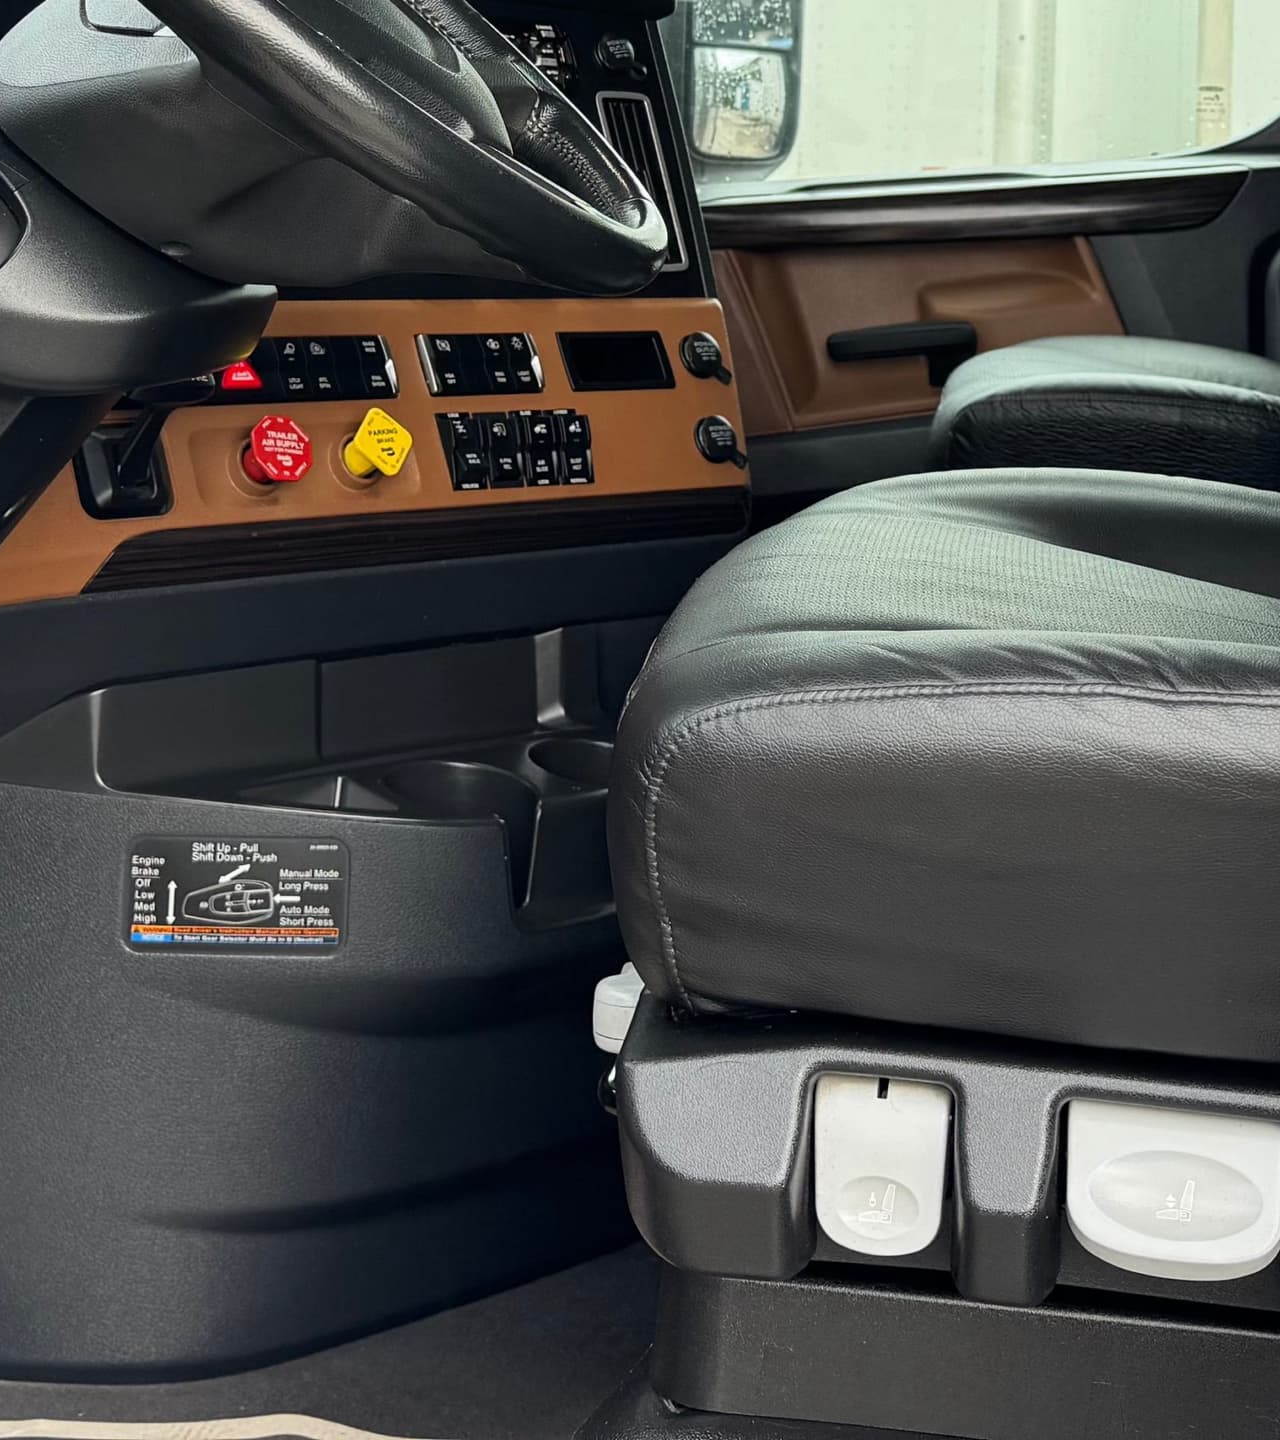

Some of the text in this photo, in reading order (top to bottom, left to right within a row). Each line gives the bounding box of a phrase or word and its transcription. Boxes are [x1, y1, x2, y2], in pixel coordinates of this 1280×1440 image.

[266, 430, 298, 441] TRAILER
[368, 427, 398, 437] PARKING
[262, 438, 305, 449] AIR SUPPLY
[192, 842, 215, 853] Shift
[217, 842, 231, 853] Up
[240, 842, 259, 853] Pull
[132, 855, 166, 866] Engine
[192, 852, 214, 862] Shift
[216, 852, 244, 862] Down
[252, 852, 278, 862] Push
[131, 866, 160, 876] Brake
[280, 868, 340, 878] Manual Mode
[135, 878, 151, 888] Off
[279, 881, 329, 892] Long Press
[134, 890, 155, 899] Low
[134, 901, 156, 911] Med
[280, 905, 330, 914] Auto Mode
[133, 913, 157, 924] High
[280, 917, 335, 927] Short Press
